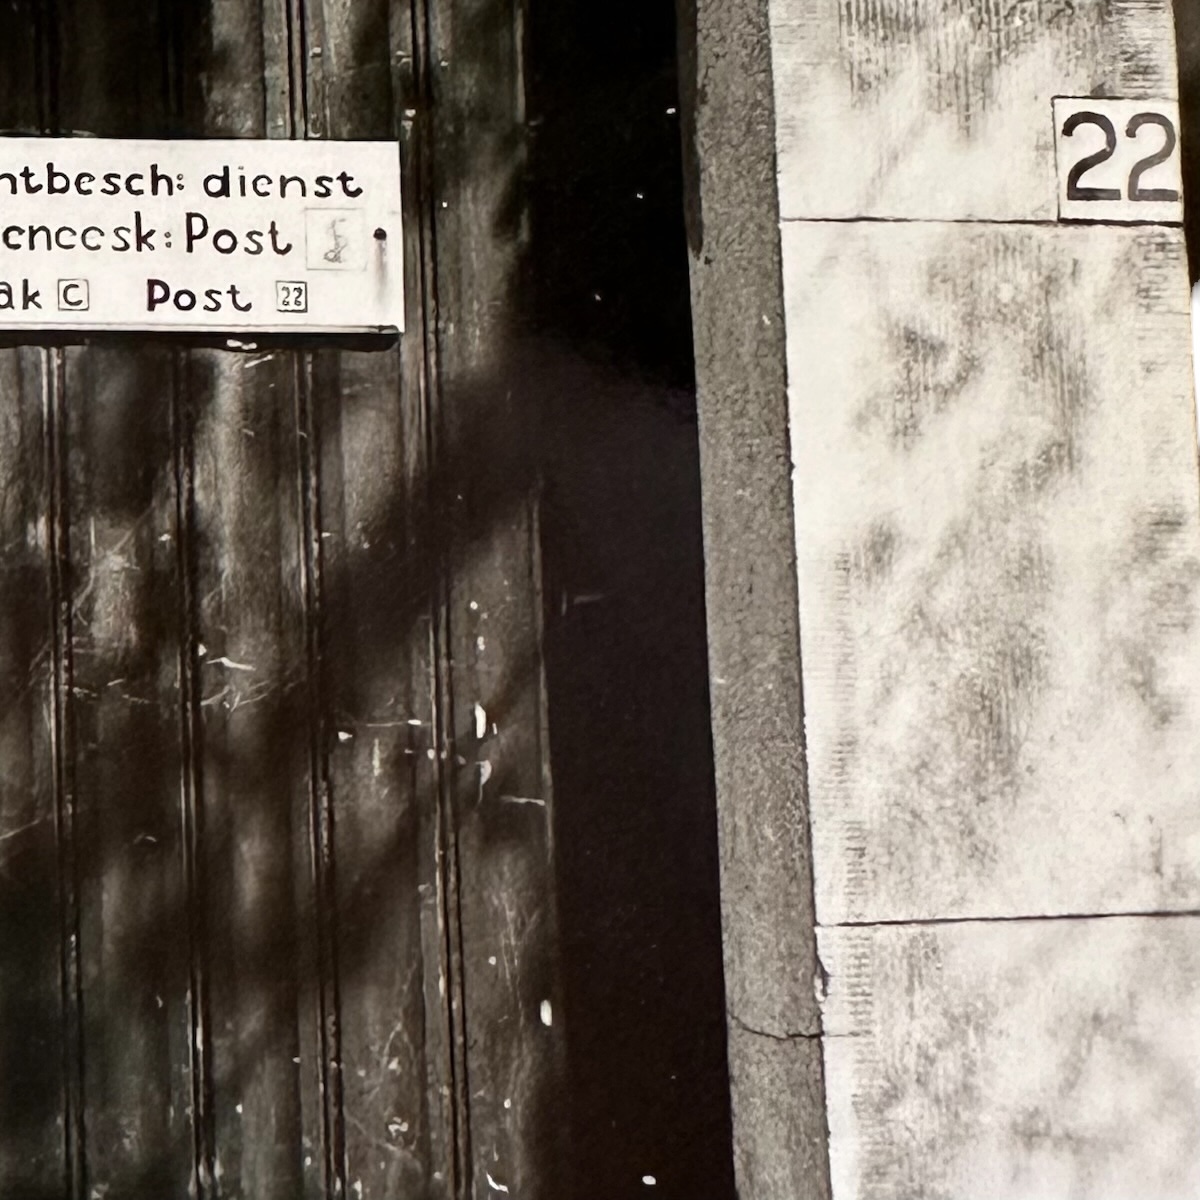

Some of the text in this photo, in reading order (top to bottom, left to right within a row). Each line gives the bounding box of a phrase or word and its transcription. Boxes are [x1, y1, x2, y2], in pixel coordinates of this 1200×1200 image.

[1062, 111, 1179, 202] 22
[202, 165, 363, 198] dienst
[186, 211, 293, 256] Post
[62, 283, 84, 307] C
[147, 278, 253, 312] Post
